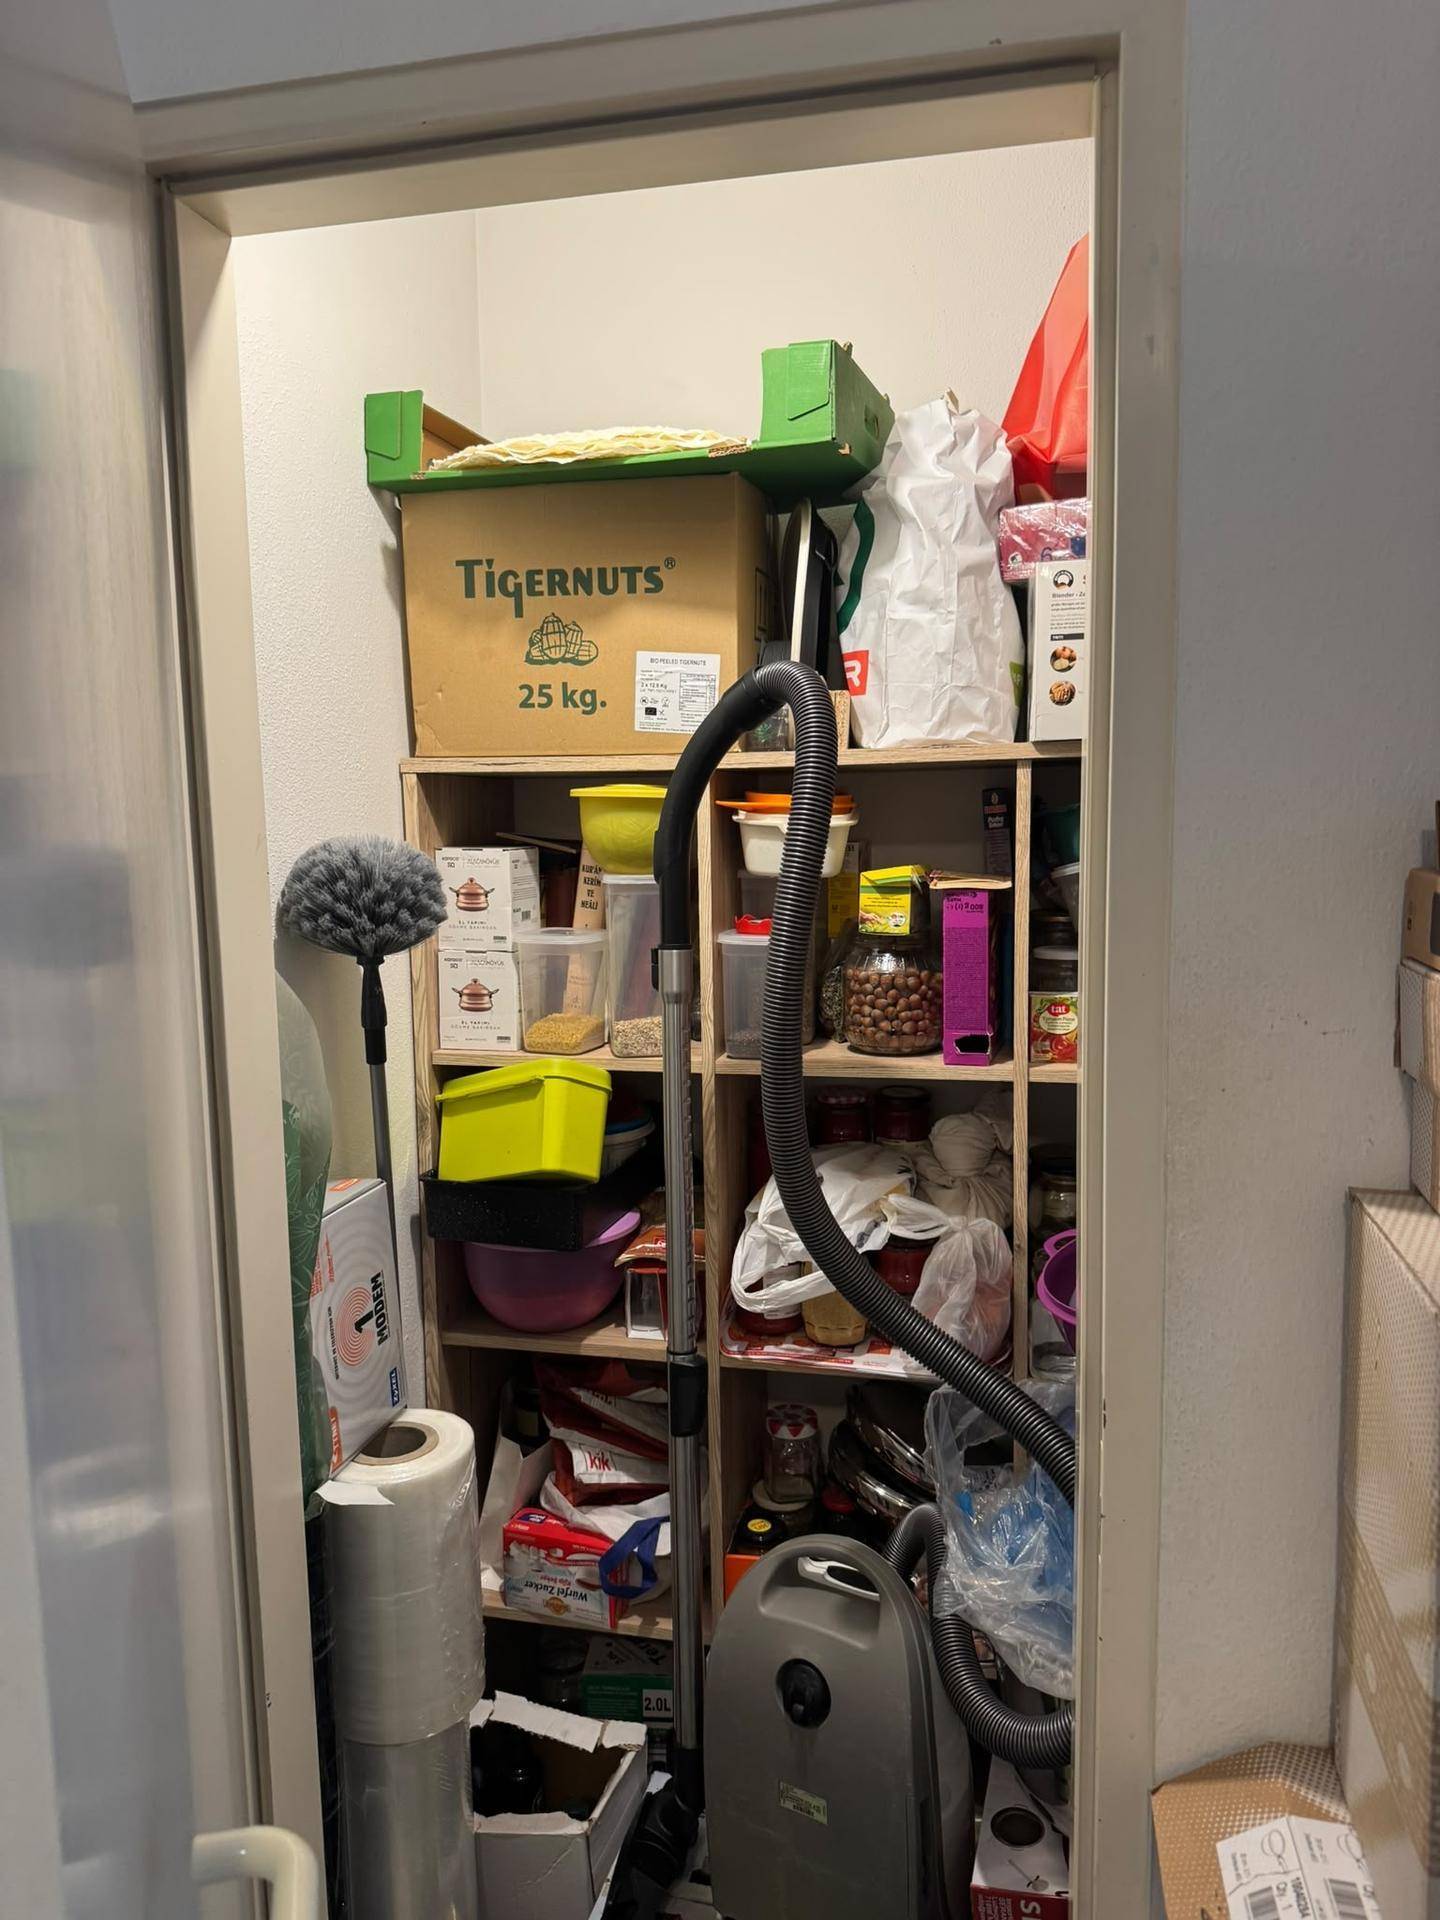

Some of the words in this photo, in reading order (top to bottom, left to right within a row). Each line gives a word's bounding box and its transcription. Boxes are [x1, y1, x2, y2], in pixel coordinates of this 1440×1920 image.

[518, 683, 553, 709] 25
[562, 682, 607, 715] kg.
[1051, 1004, 1066, 1013] tat
[370, 1271, 388, 1347] MODEM
[354, 1310, 373, 1334] 1
[587, 1450, 612, 1472] kik
[524, 1579, 555, 1596] Zucker
[556, 1587, 588, 1603] Würfel
[644, 1697, 671, 1712] 2.0L
